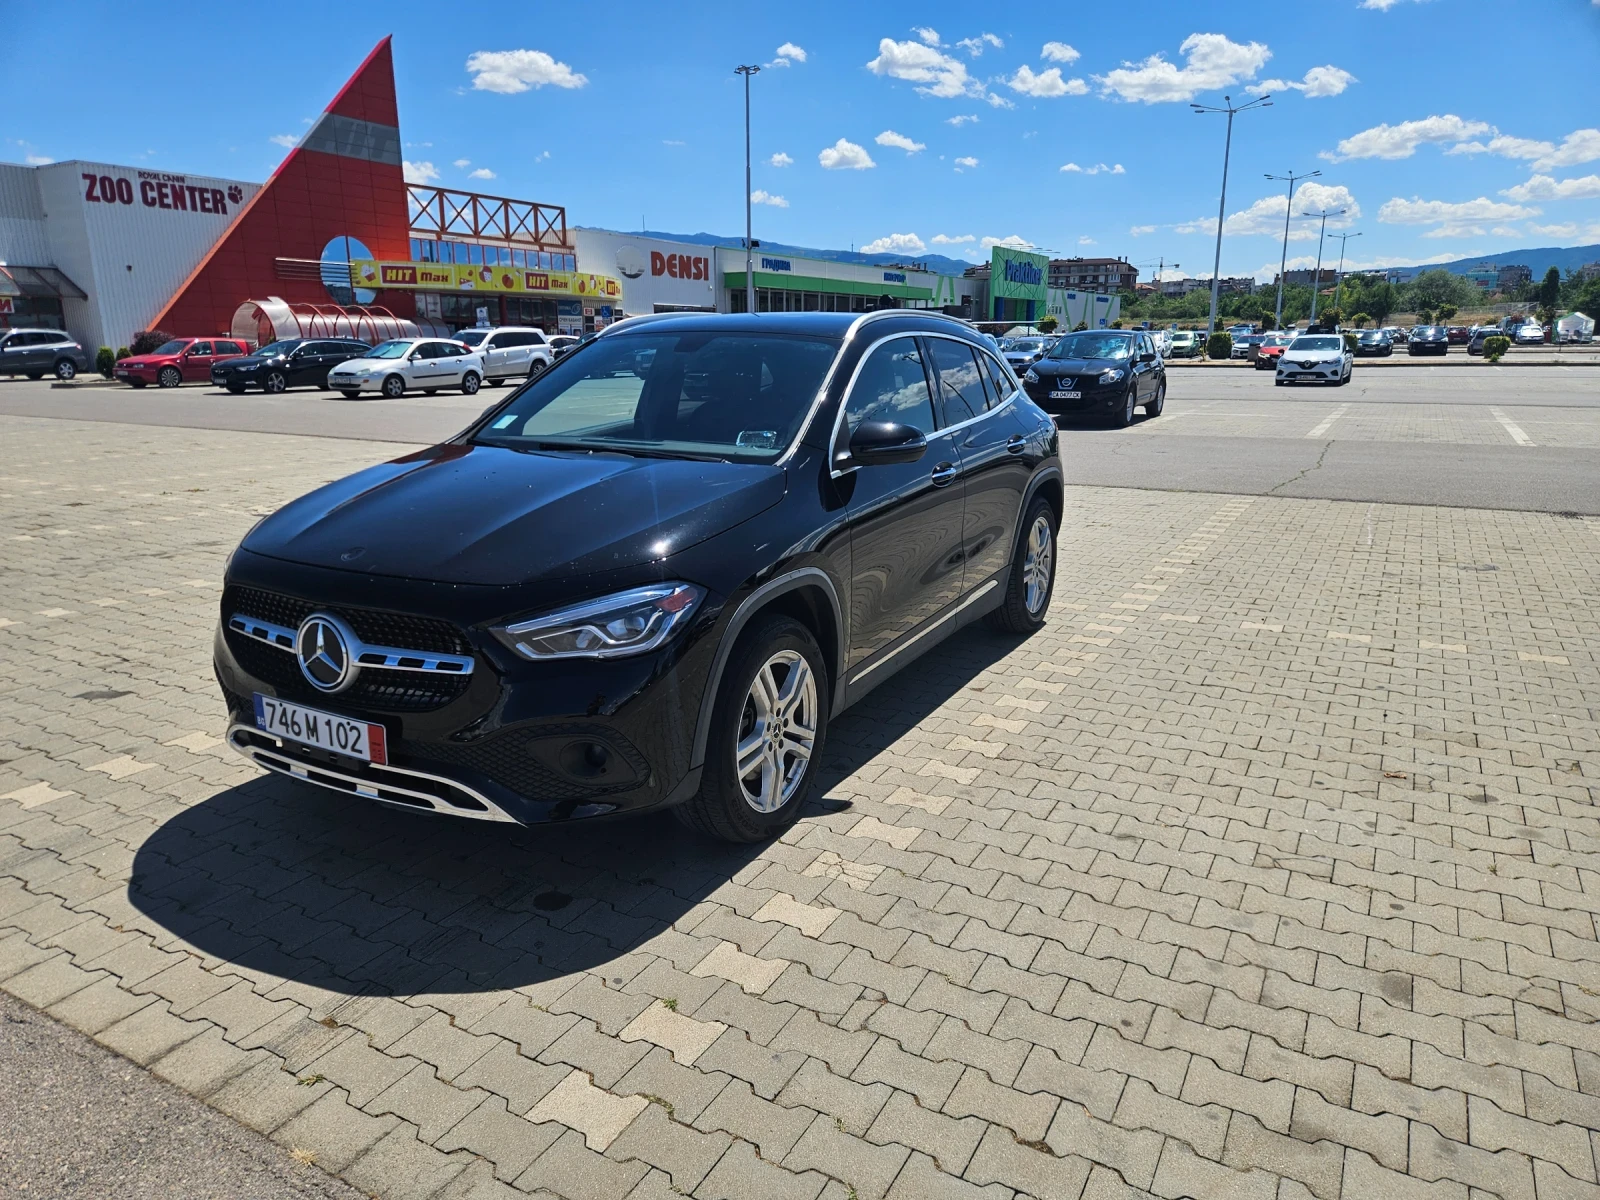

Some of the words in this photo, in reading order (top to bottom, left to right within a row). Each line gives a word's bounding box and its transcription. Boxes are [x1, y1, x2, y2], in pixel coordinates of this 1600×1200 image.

[138, 171, 161, 181] ROYAL
[162, 174, 185, 184] CANIN
[82, 173, 134, 205] ZOO
[140, 181, 228, 215] CENTER
[386, 269, 412, 281] HIT
[420, 271, 449, 282] Max
[650, 251, 709, 281] DENSI
[1004, 259, 1042, 285] Praktiker
[528, 275, 547, 287] HIT
[551, 279, 568, 289] Max
[265, 702, 302, 737] 746
[304, 713, 319, 742] M
[325, 718, 363, 754] 102
